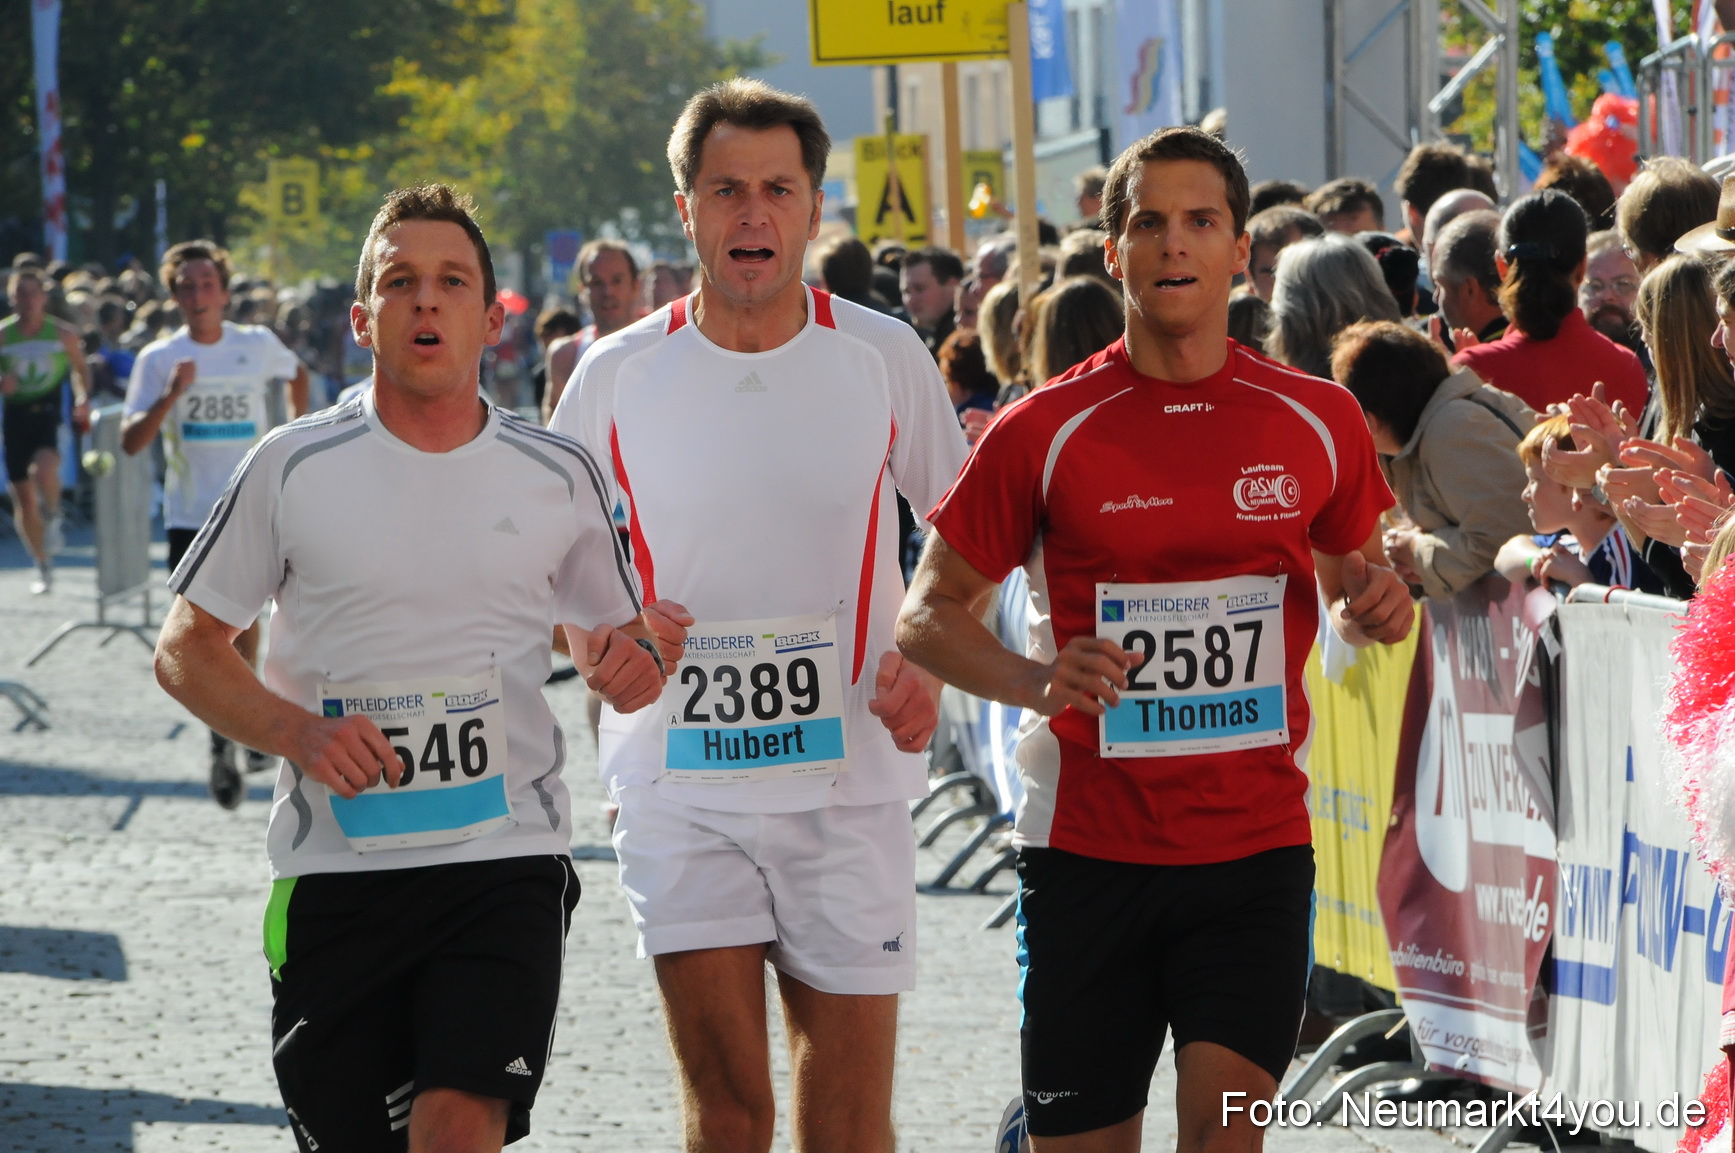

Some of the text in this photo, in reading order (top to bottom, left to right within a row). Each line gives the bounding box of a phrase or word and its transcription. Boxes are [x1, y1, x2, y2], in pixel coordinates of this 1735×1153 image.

[888, 0, 946, 25] lauf
[862, 142, 921, 163] Blck
[282, 182, 306, 216] B
[876, 172, 916, 225] A
[734, 384, 769, 393] adidas
[187, 395, 250, 421] 2885
[1164, 403, 1204, 414] CRAFT
[1241, 464, 1284, 475] Laufteam
[1250, 477, 1275, 497] ASV
[1236, 509, 1301, 522] Kraftsport & Fitness
[1128, 591, 1270, 612] PFLEIDERER BOCK
[1128, 613, 1210, 623] AKTIENGESELLSCHAFT
[684, 631, 820, 650] PFLEIDERER BOCK
[684, 650, 756, 660] AKTIENGESELLSCHAFT
[1122, 620, 1263, 691] 2587
[346, 689, 488, 712] PFLEIDERER BOCK
[680, 657, 820, 724] 2389
[671, 715, 678, 725] A
[1135, 698, 1259, 733] Thomas
[381, 718, 488, 787] 546
[703, 724, 805, 761] Hubert
[1468, 743, 1487, 812] ZU
[1417, 1016, 1440, 1042] für
[505, 1065, 532, 1076] adidas
[1041, 1090, 1071, 1099] TOUCH
